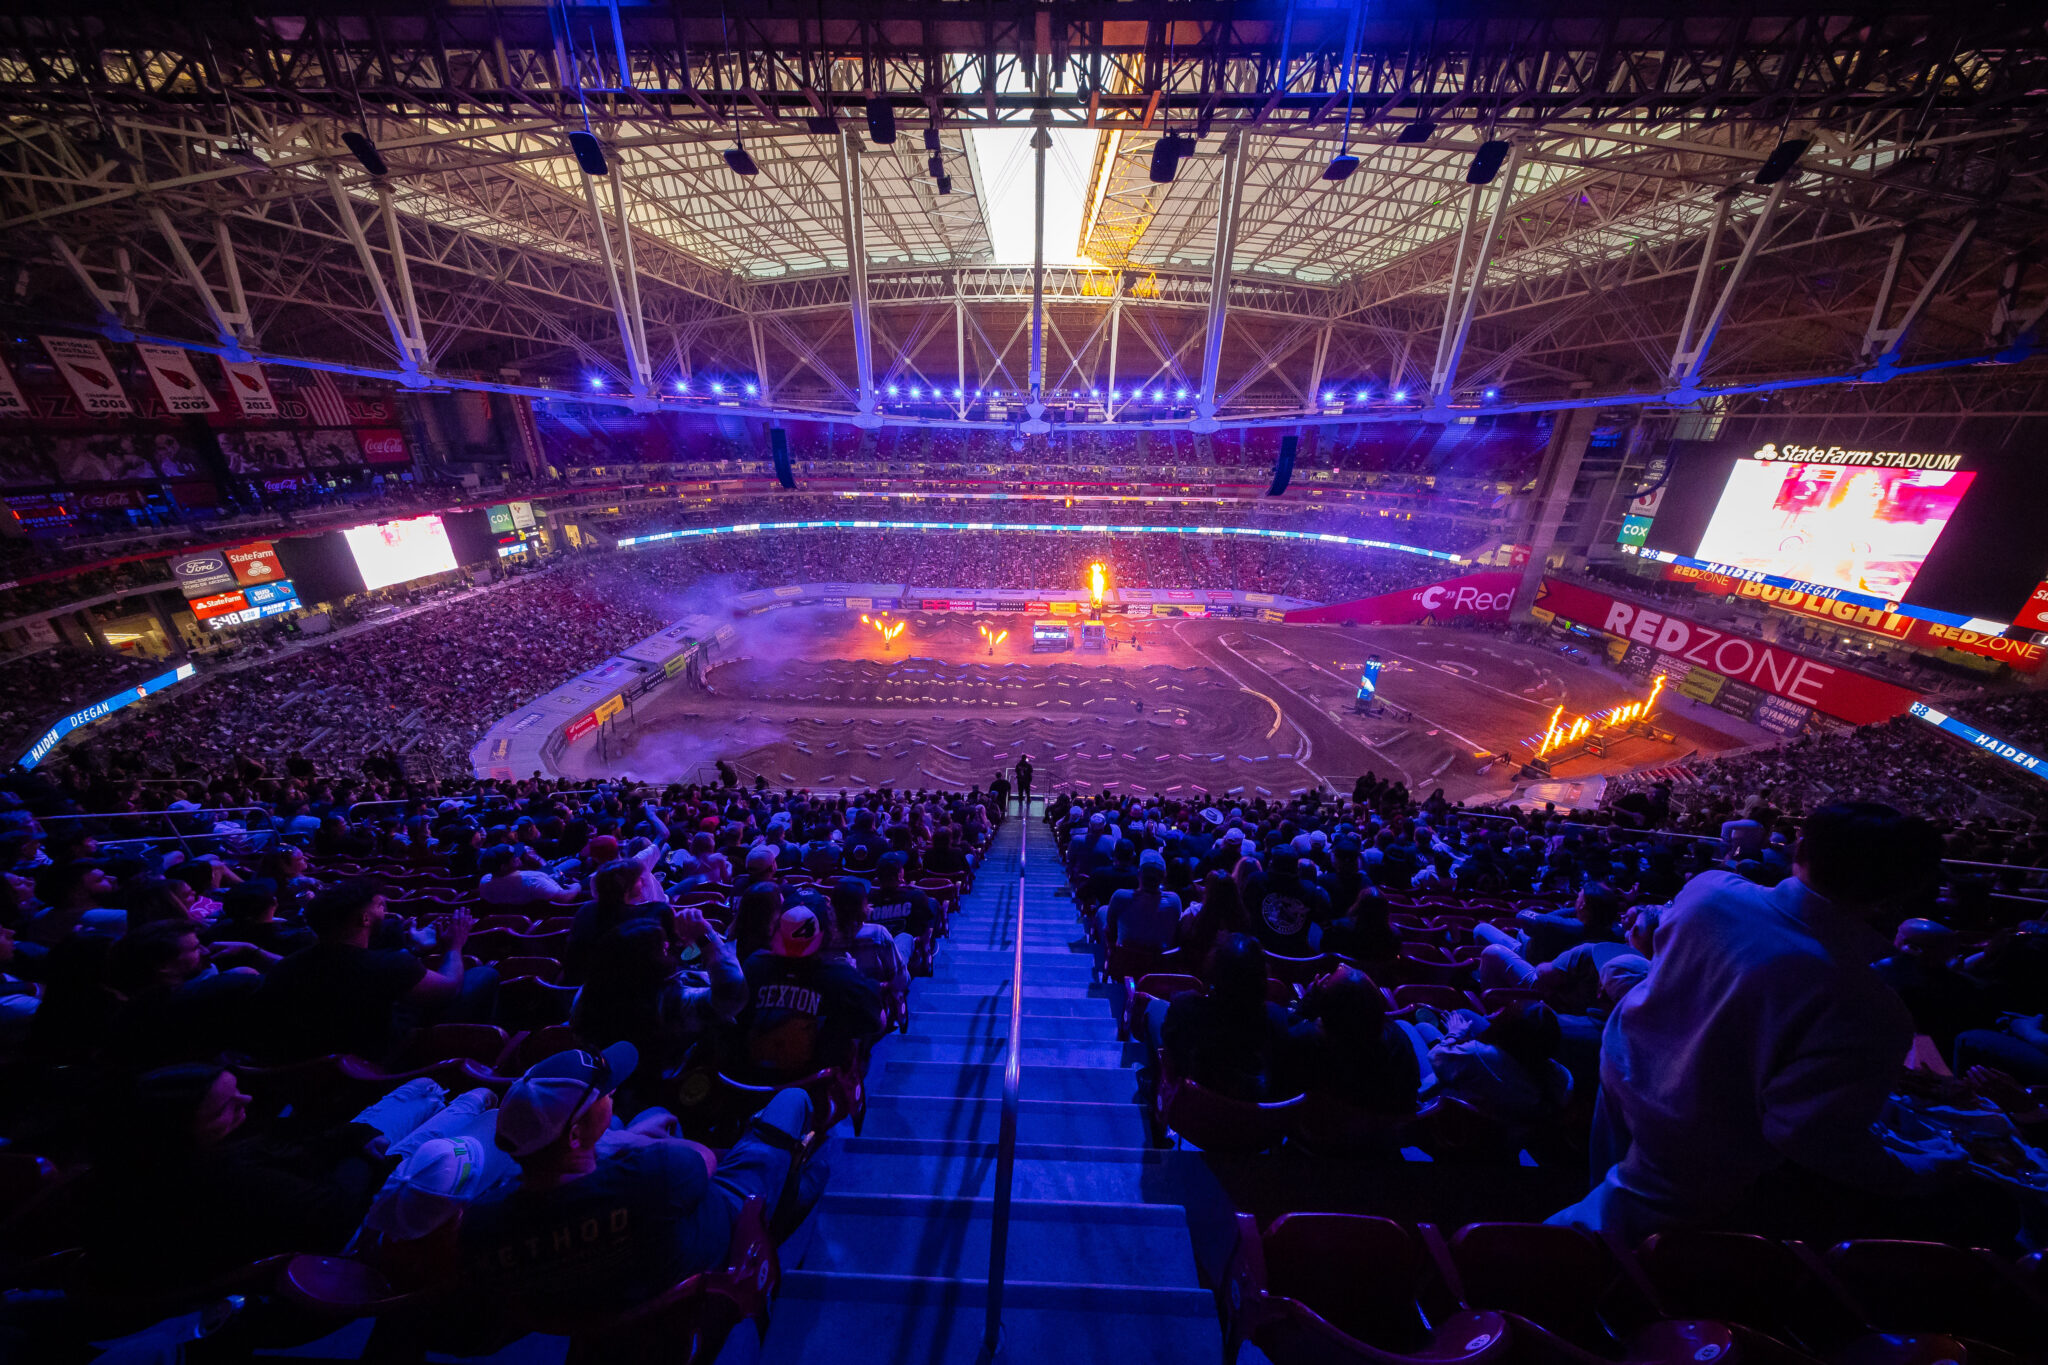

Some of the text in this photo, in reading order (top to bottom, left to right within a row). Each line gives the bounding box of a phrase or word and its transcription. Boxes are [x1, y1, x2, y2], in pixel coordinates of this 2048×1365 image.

[88, 399, 127, 409] 2008
[171, 401, 211, 410] 2009
[245, 401, 272, 410] 2015
[1871, 452, 1962, 470] STADIUM
[490, 513, 510, 524] COX
[1623, 524, 1649, 536] COX
[186, 561, 214, 574] Ford
[1673, 564, 1729, 586] REDZONE
[1705, 562, 1842, 600] HAIDEN DEEGAN
[253, 592, 275, 602] LIGHT
[254, 588, 270, 596] BUD
[1454, 586, 1516, 611] Red
[1741, 580, 1815, 606] BUD
[209, 612, 241, 630] 5:48
[1929, 622, 2046, 660] REDZONE
[1604, 604, 1835, 705] REDZONE
[70, 702, 110, 728] DEEGAN
[1776, 698, 1808, 717] YAMAHA
[1912, 703, 1930, 717] 38
[1768, 709, 1800, 728] YAMAHA
[31, 728, 60, 762] HAIDEN
[1974, 733, 2041, 769] HAIDEN
[755, 984, 822, 1016] SEXTON
